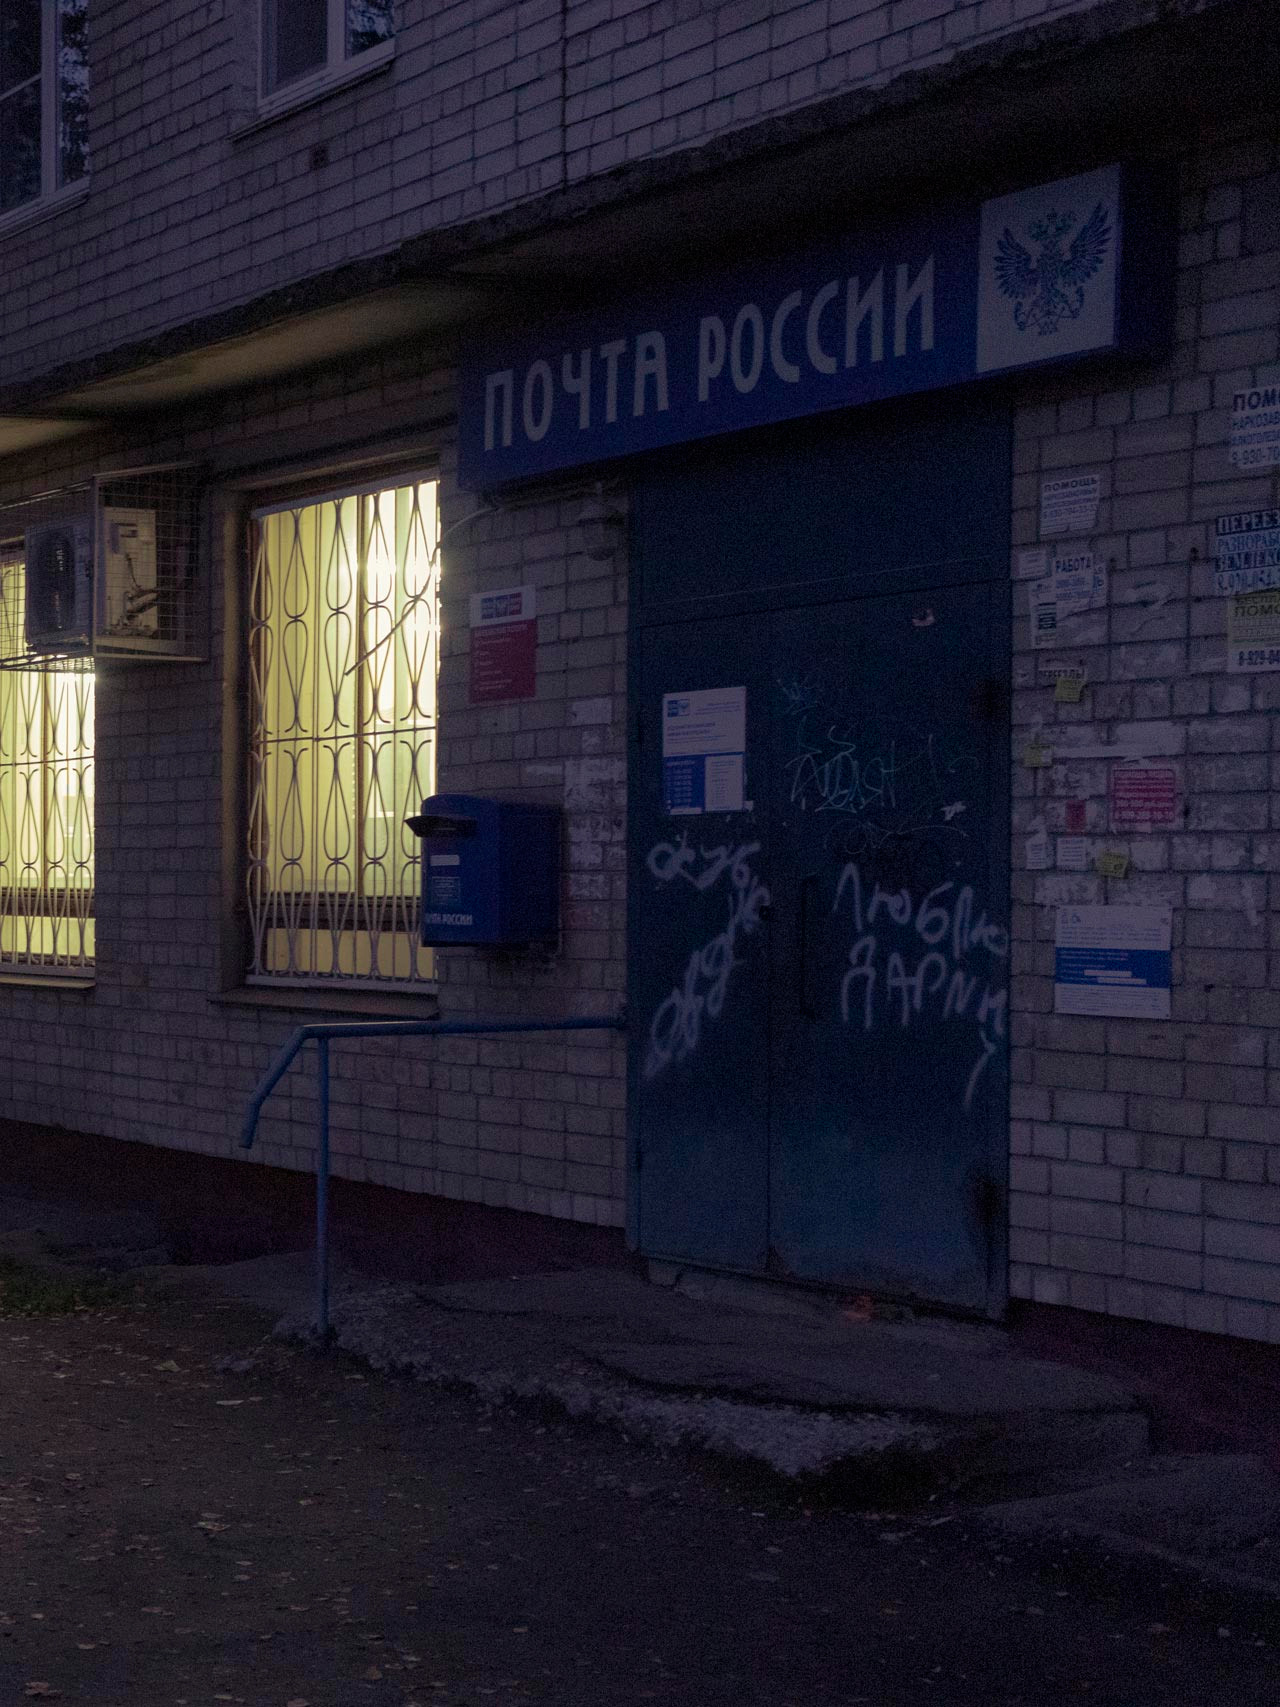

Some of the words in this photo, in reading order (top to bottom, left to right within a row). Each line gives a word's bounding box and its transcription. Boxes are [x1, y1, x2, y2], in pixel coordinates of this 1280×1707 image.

[483, 330, 669, 451] ПОЧТА
[697, 255, 935, 402] РОССИИ
[1233, 387, 1280, 412] ПОМ
[1044, 477, 1097, 492] ПОМОЩЬ
[1055, 556, 1091, 574] РАБОТА
